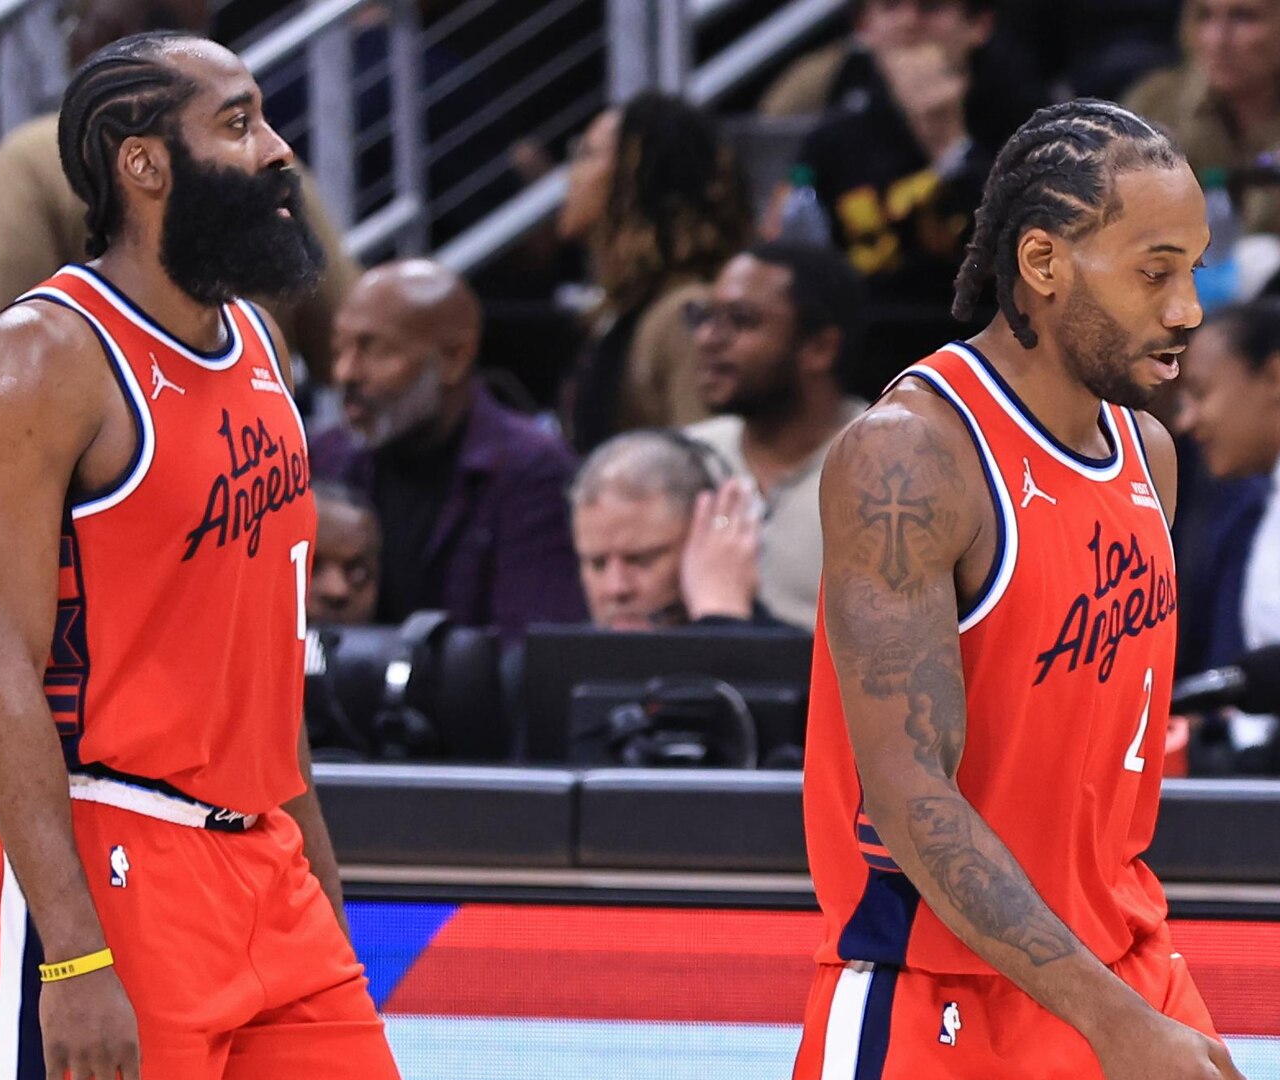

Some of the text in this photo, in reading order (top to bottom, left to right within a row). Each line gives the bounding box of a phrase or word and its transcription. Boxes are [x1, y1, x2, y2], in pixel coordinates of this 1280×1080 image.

[217, 407, 278, 479] Los
[290, 539, 310, 641] 1
[1088, 520, 1147, 600] Los
[1123, 667, 1153, 773] 2
